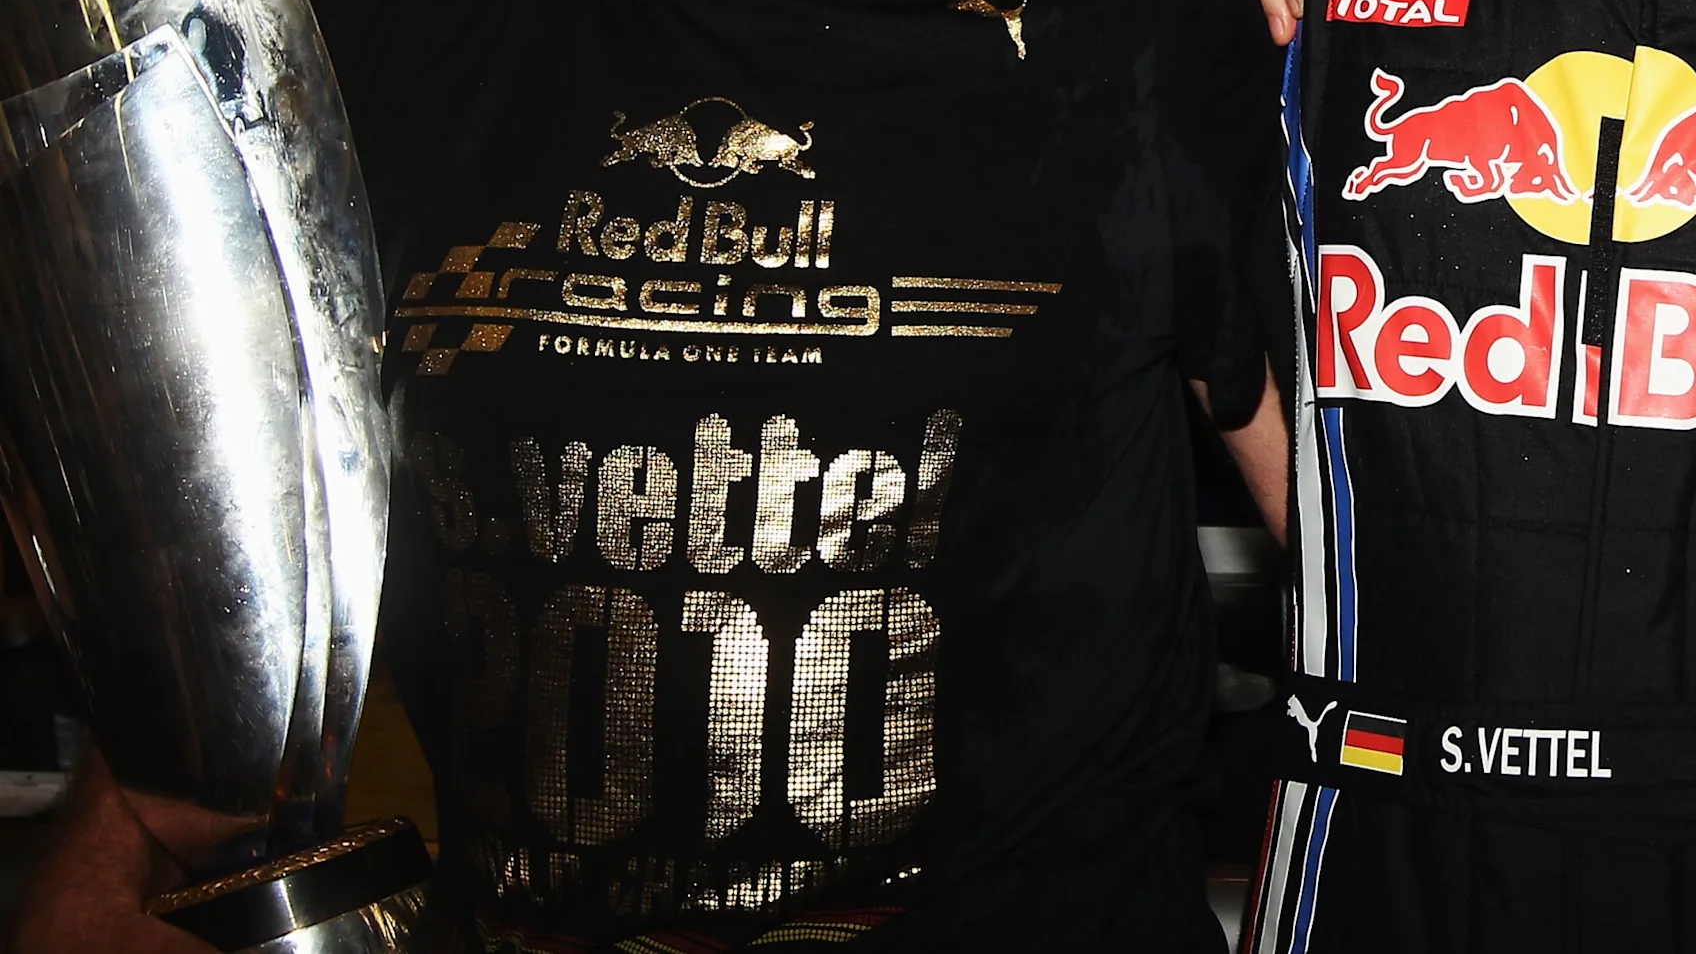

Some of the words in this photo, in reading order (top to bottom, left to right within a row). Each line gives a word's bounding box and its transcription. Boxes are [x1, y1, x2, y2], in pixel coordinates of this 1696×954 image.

[557, 189, 695, 262] Red
[699, 199, 835, 270] Bull
[496, 266, 882, 337] racing
[1315, 244, 1567, 421] Red
[538, 334, 671, 362] FORMULA
[682, 344, 740, 364] ONE
[752, 346, 823, 365] TEAM
